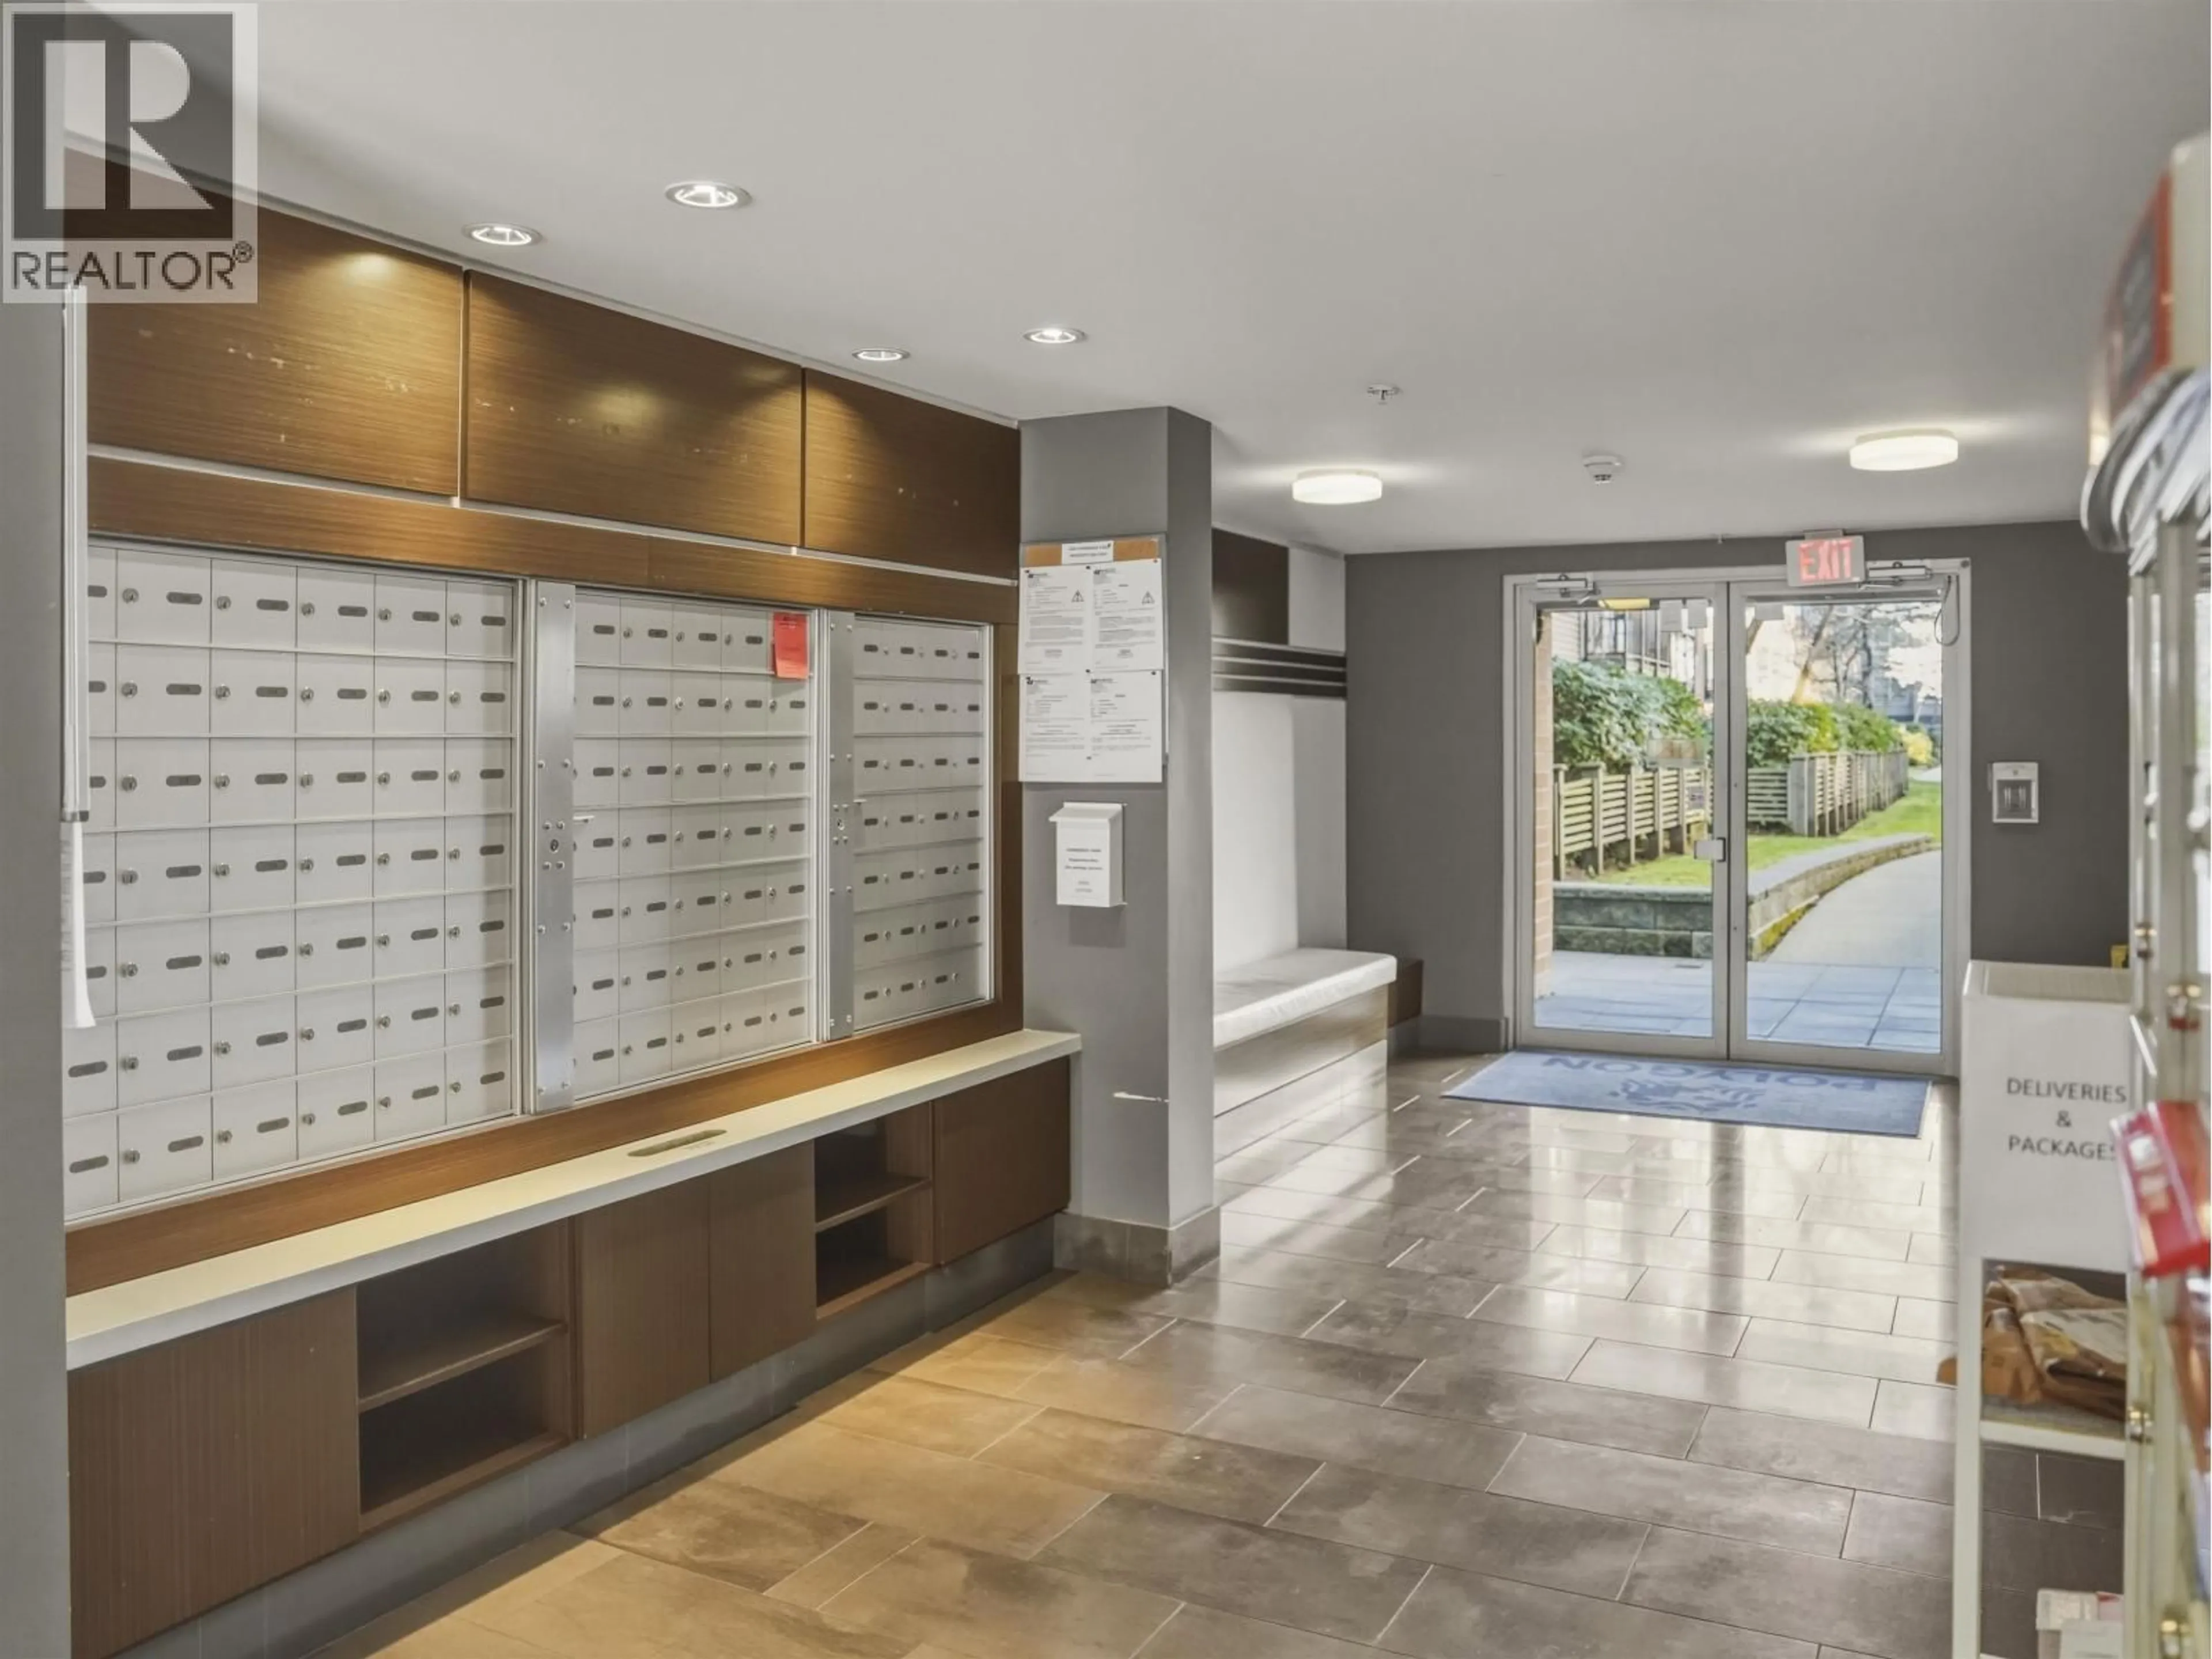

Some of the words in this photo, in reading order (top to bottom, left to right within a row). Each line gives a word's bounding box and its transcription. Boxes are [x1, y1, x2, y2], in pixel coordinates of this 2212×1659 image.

[1798, 540, 1854, 583] EXIT
[1540, 1056, 1878, 1091] POLYGON
[2007, 1078, 2127, 1103] DELIVERIES
[2055, 1110, 2073, 1128] &
